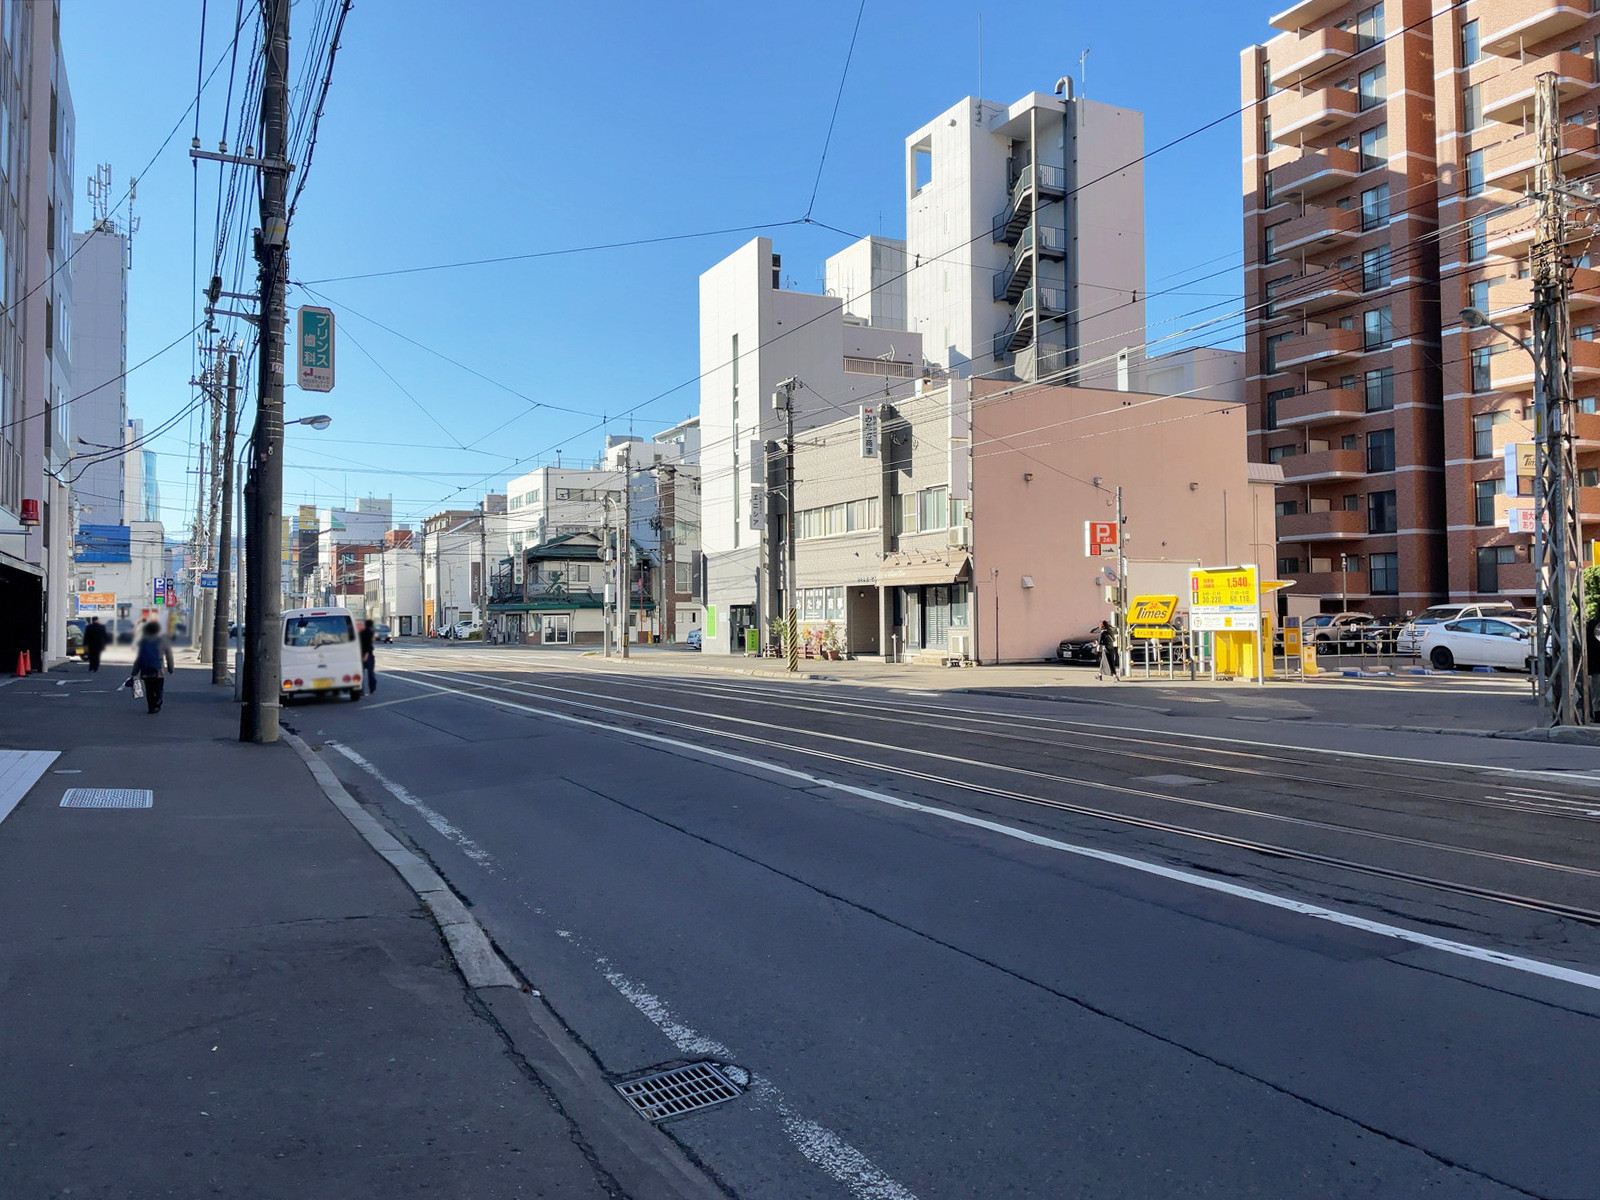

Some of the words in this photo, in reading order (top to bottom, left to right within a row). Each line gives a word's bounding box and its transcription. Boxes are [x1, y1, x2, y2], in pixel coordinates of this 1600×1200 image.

[304, 334, 316, 365] 歯科
[316, 315, 329, 366] プリンス
[1096, 524, 1111, 543] P
[1136, 602, 1168, 620] Times
